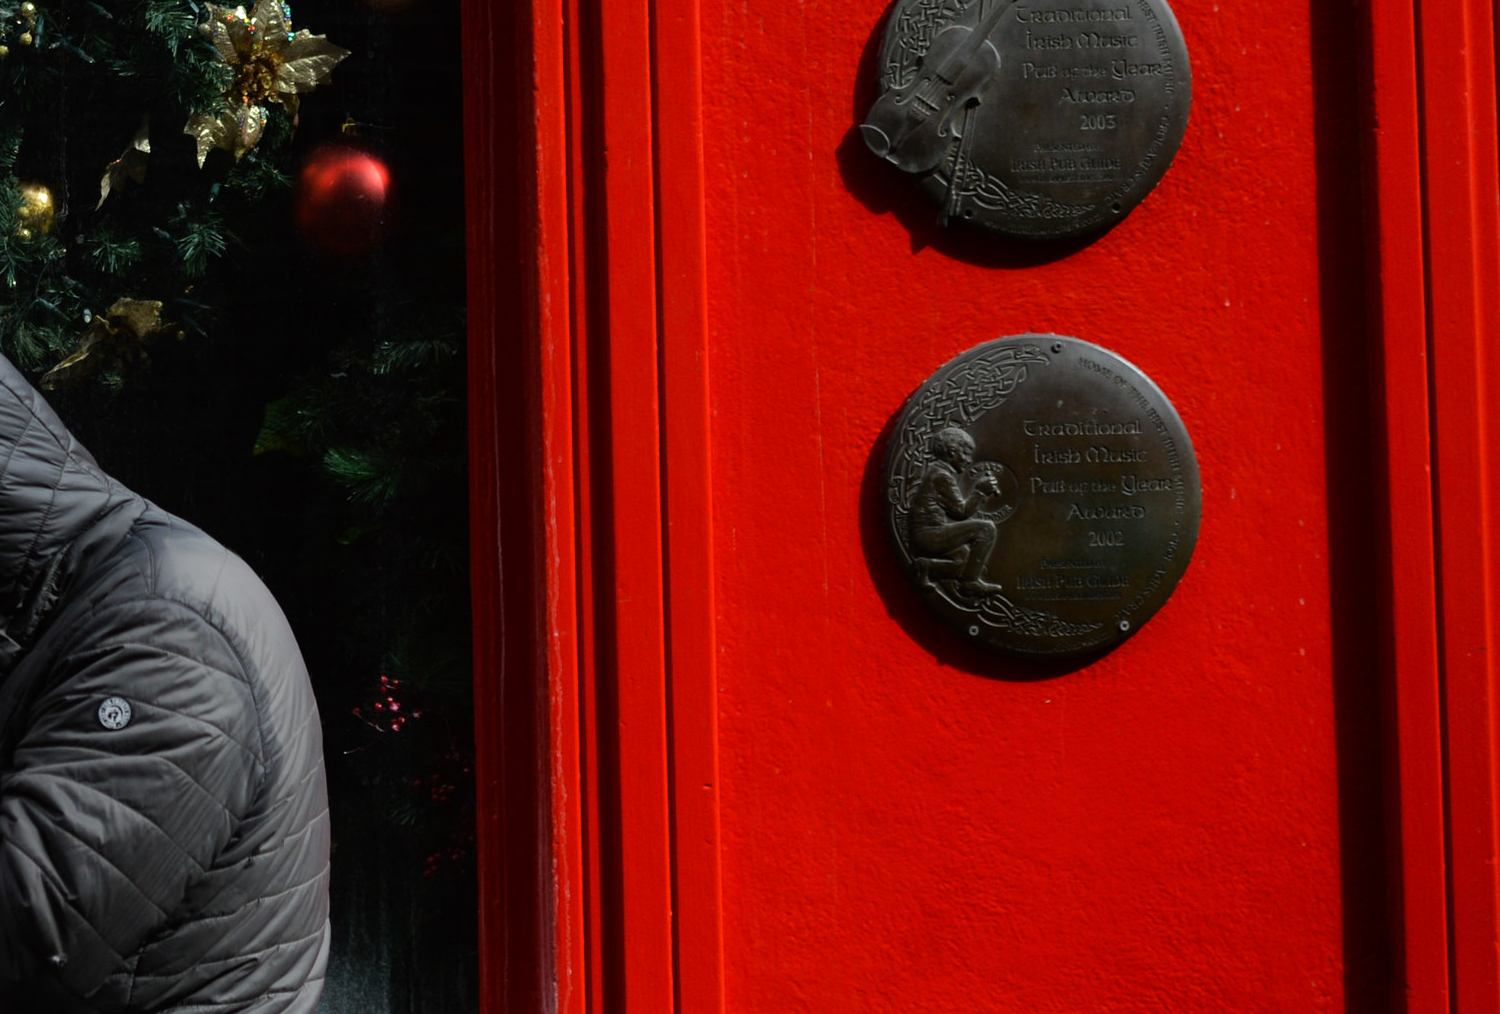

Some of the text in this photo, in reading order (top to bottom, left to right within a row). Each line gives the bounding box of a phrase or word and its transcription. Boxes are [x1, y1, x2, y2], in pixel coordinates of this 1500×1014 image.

[1026, 29, 1138, 50] Irish Music
[1082, 66, 1107, 78] the
[1080, 114, 1116, 129] 2003
[1034, 443, 1148, 464] Irish Music
[1088, 531, 1125, 547] 2002
